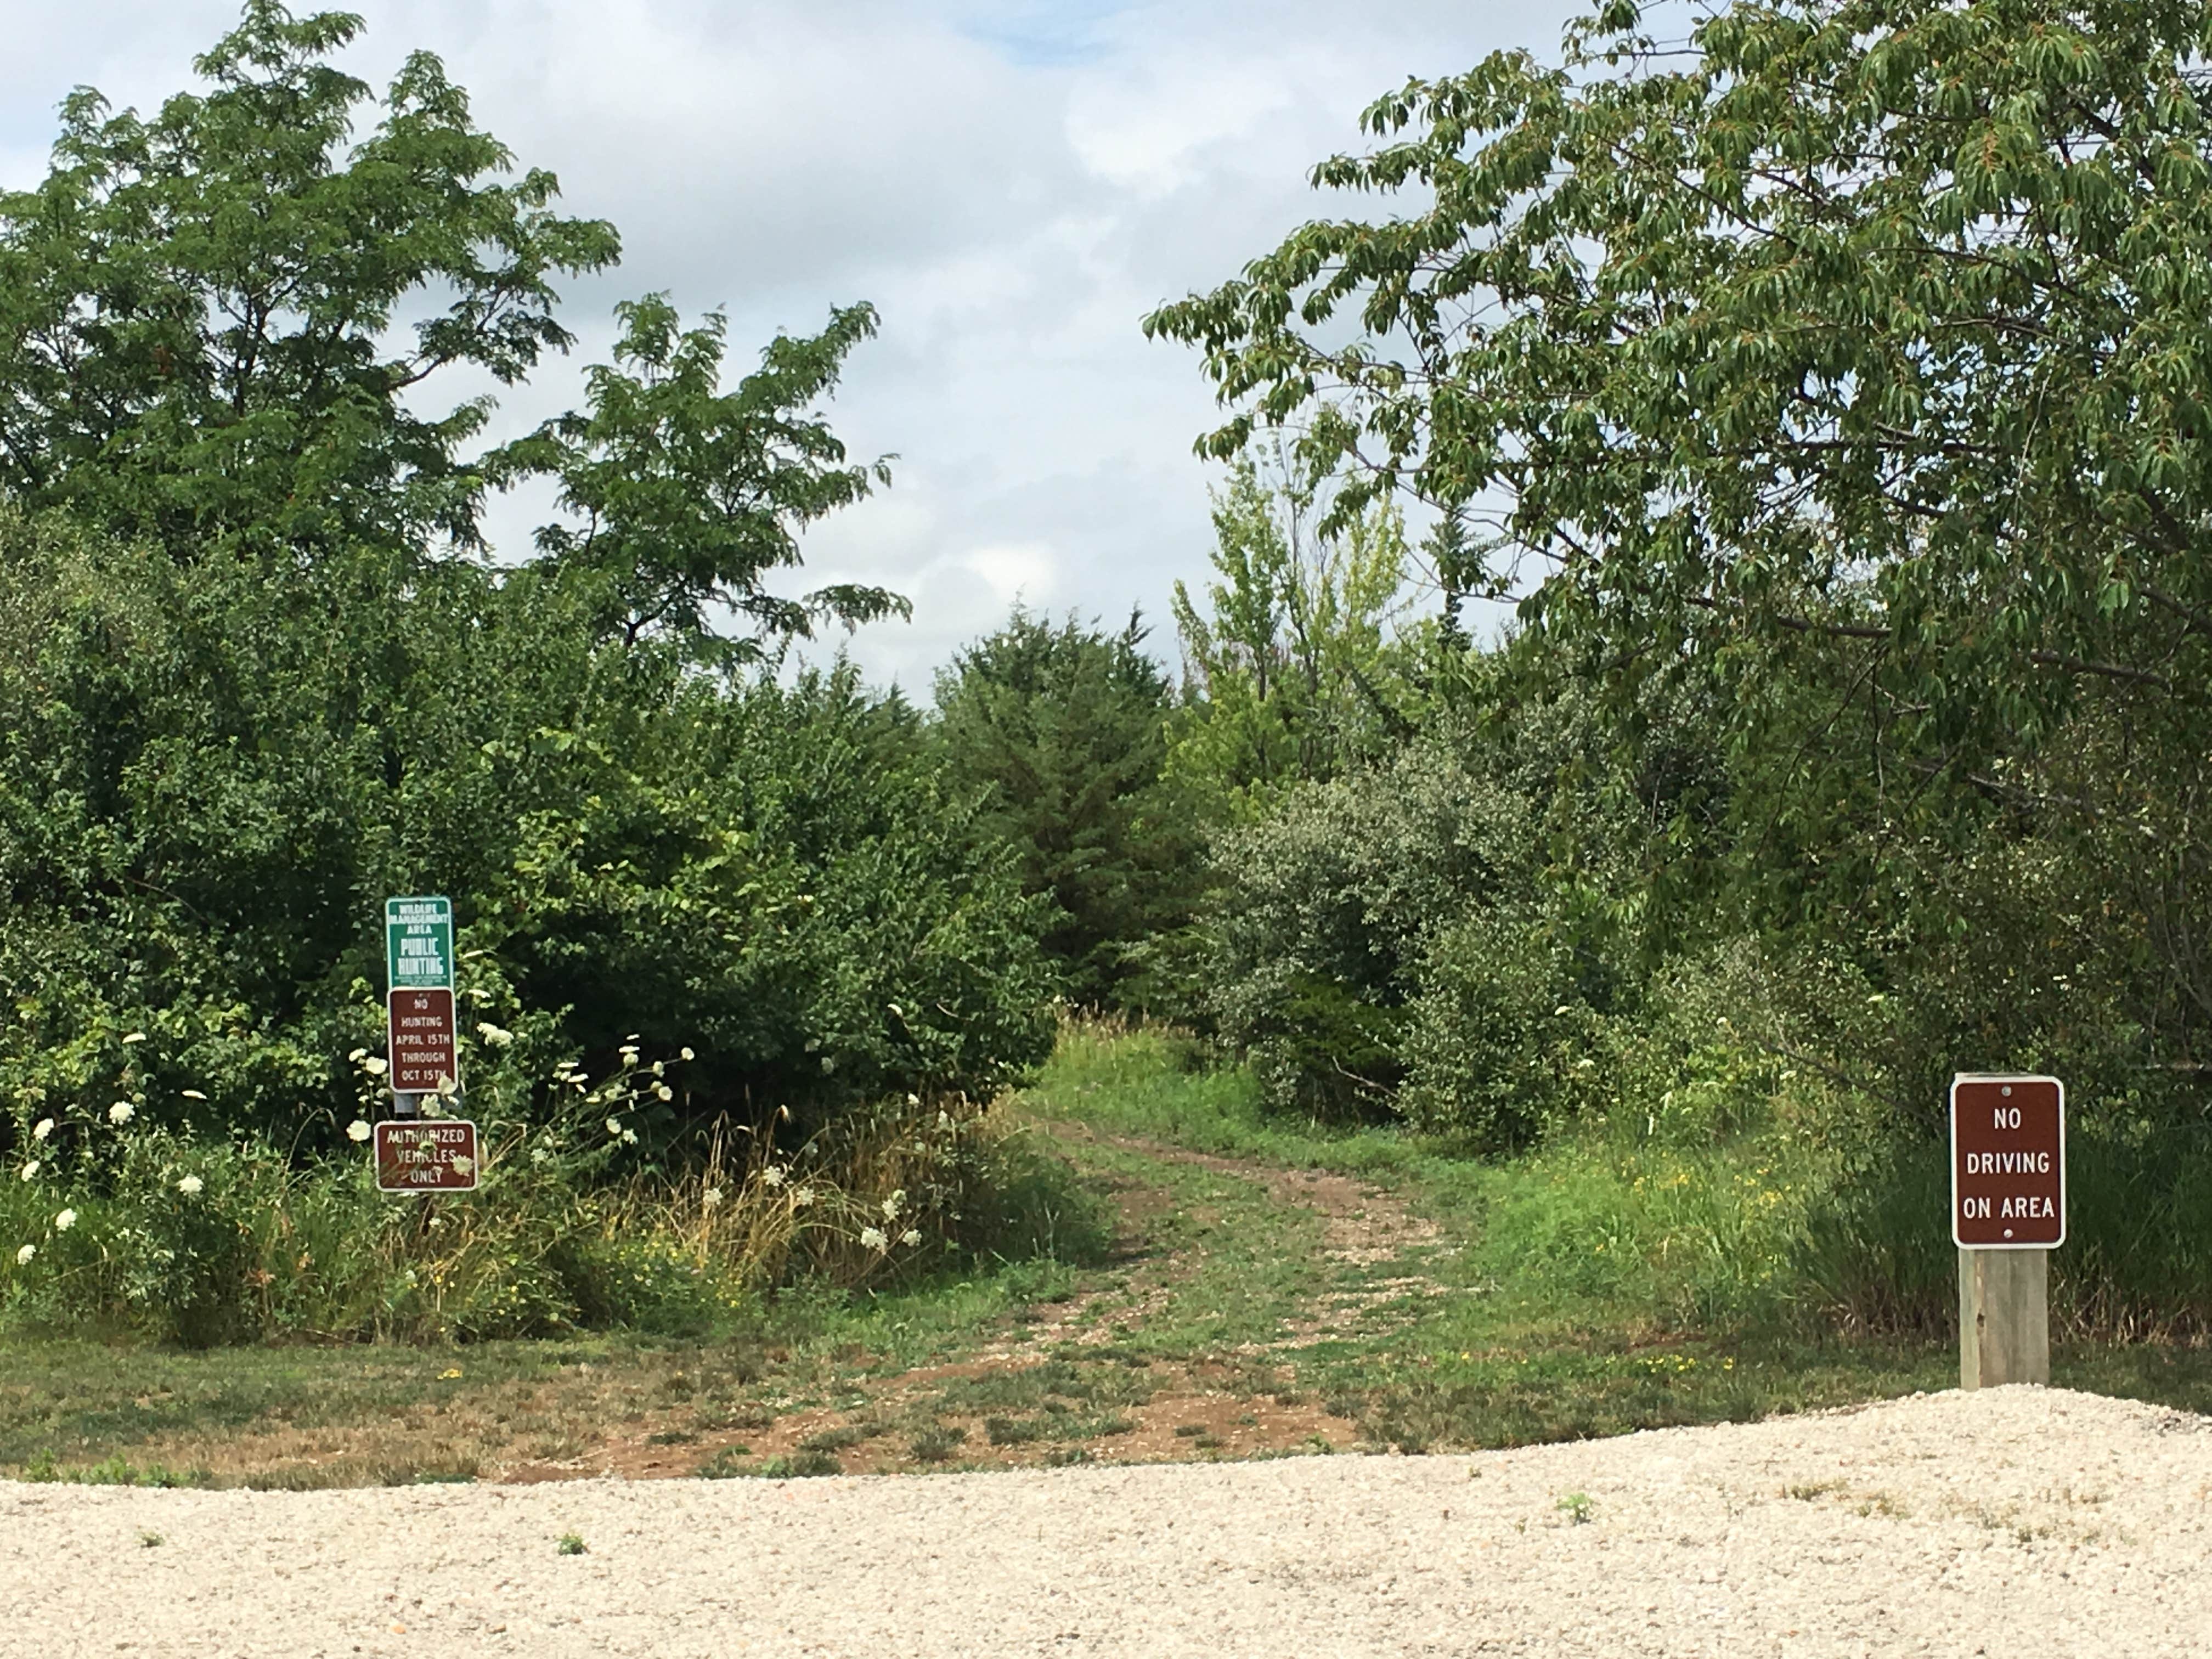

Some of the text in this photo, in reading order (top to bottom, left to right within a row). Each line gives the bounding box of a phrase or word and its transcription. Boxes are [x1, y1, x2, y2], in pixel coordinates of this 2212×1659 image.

[399, 904, 437, 914] WILDLIFE
[388, 914, 448, 924] MANAGEMENT
[407, 924, 432, 934] AREA
[401, 938, 438, 956] PUBLIC
[398, 957, 443, 975] HUNTING
[414, 998, 428, 1009] NO
[401, 1016, 442, 1028] HUNTING
[396, 1034, 450, 1045] APRIL 15TH
[402, 1052, 445, 1063] THROUGH
[402, 1070, 420, 1081] OCT
[1994, 1107, 2021, 1129] NO
[387, 1129, 465, 1144] AUTHORIZED
[1967, 1152, 2050, 1174] DRIVING
[410, 1169, 443, 1183] ONLY
[1963, 1197, 2055, 1219] ON AREA
